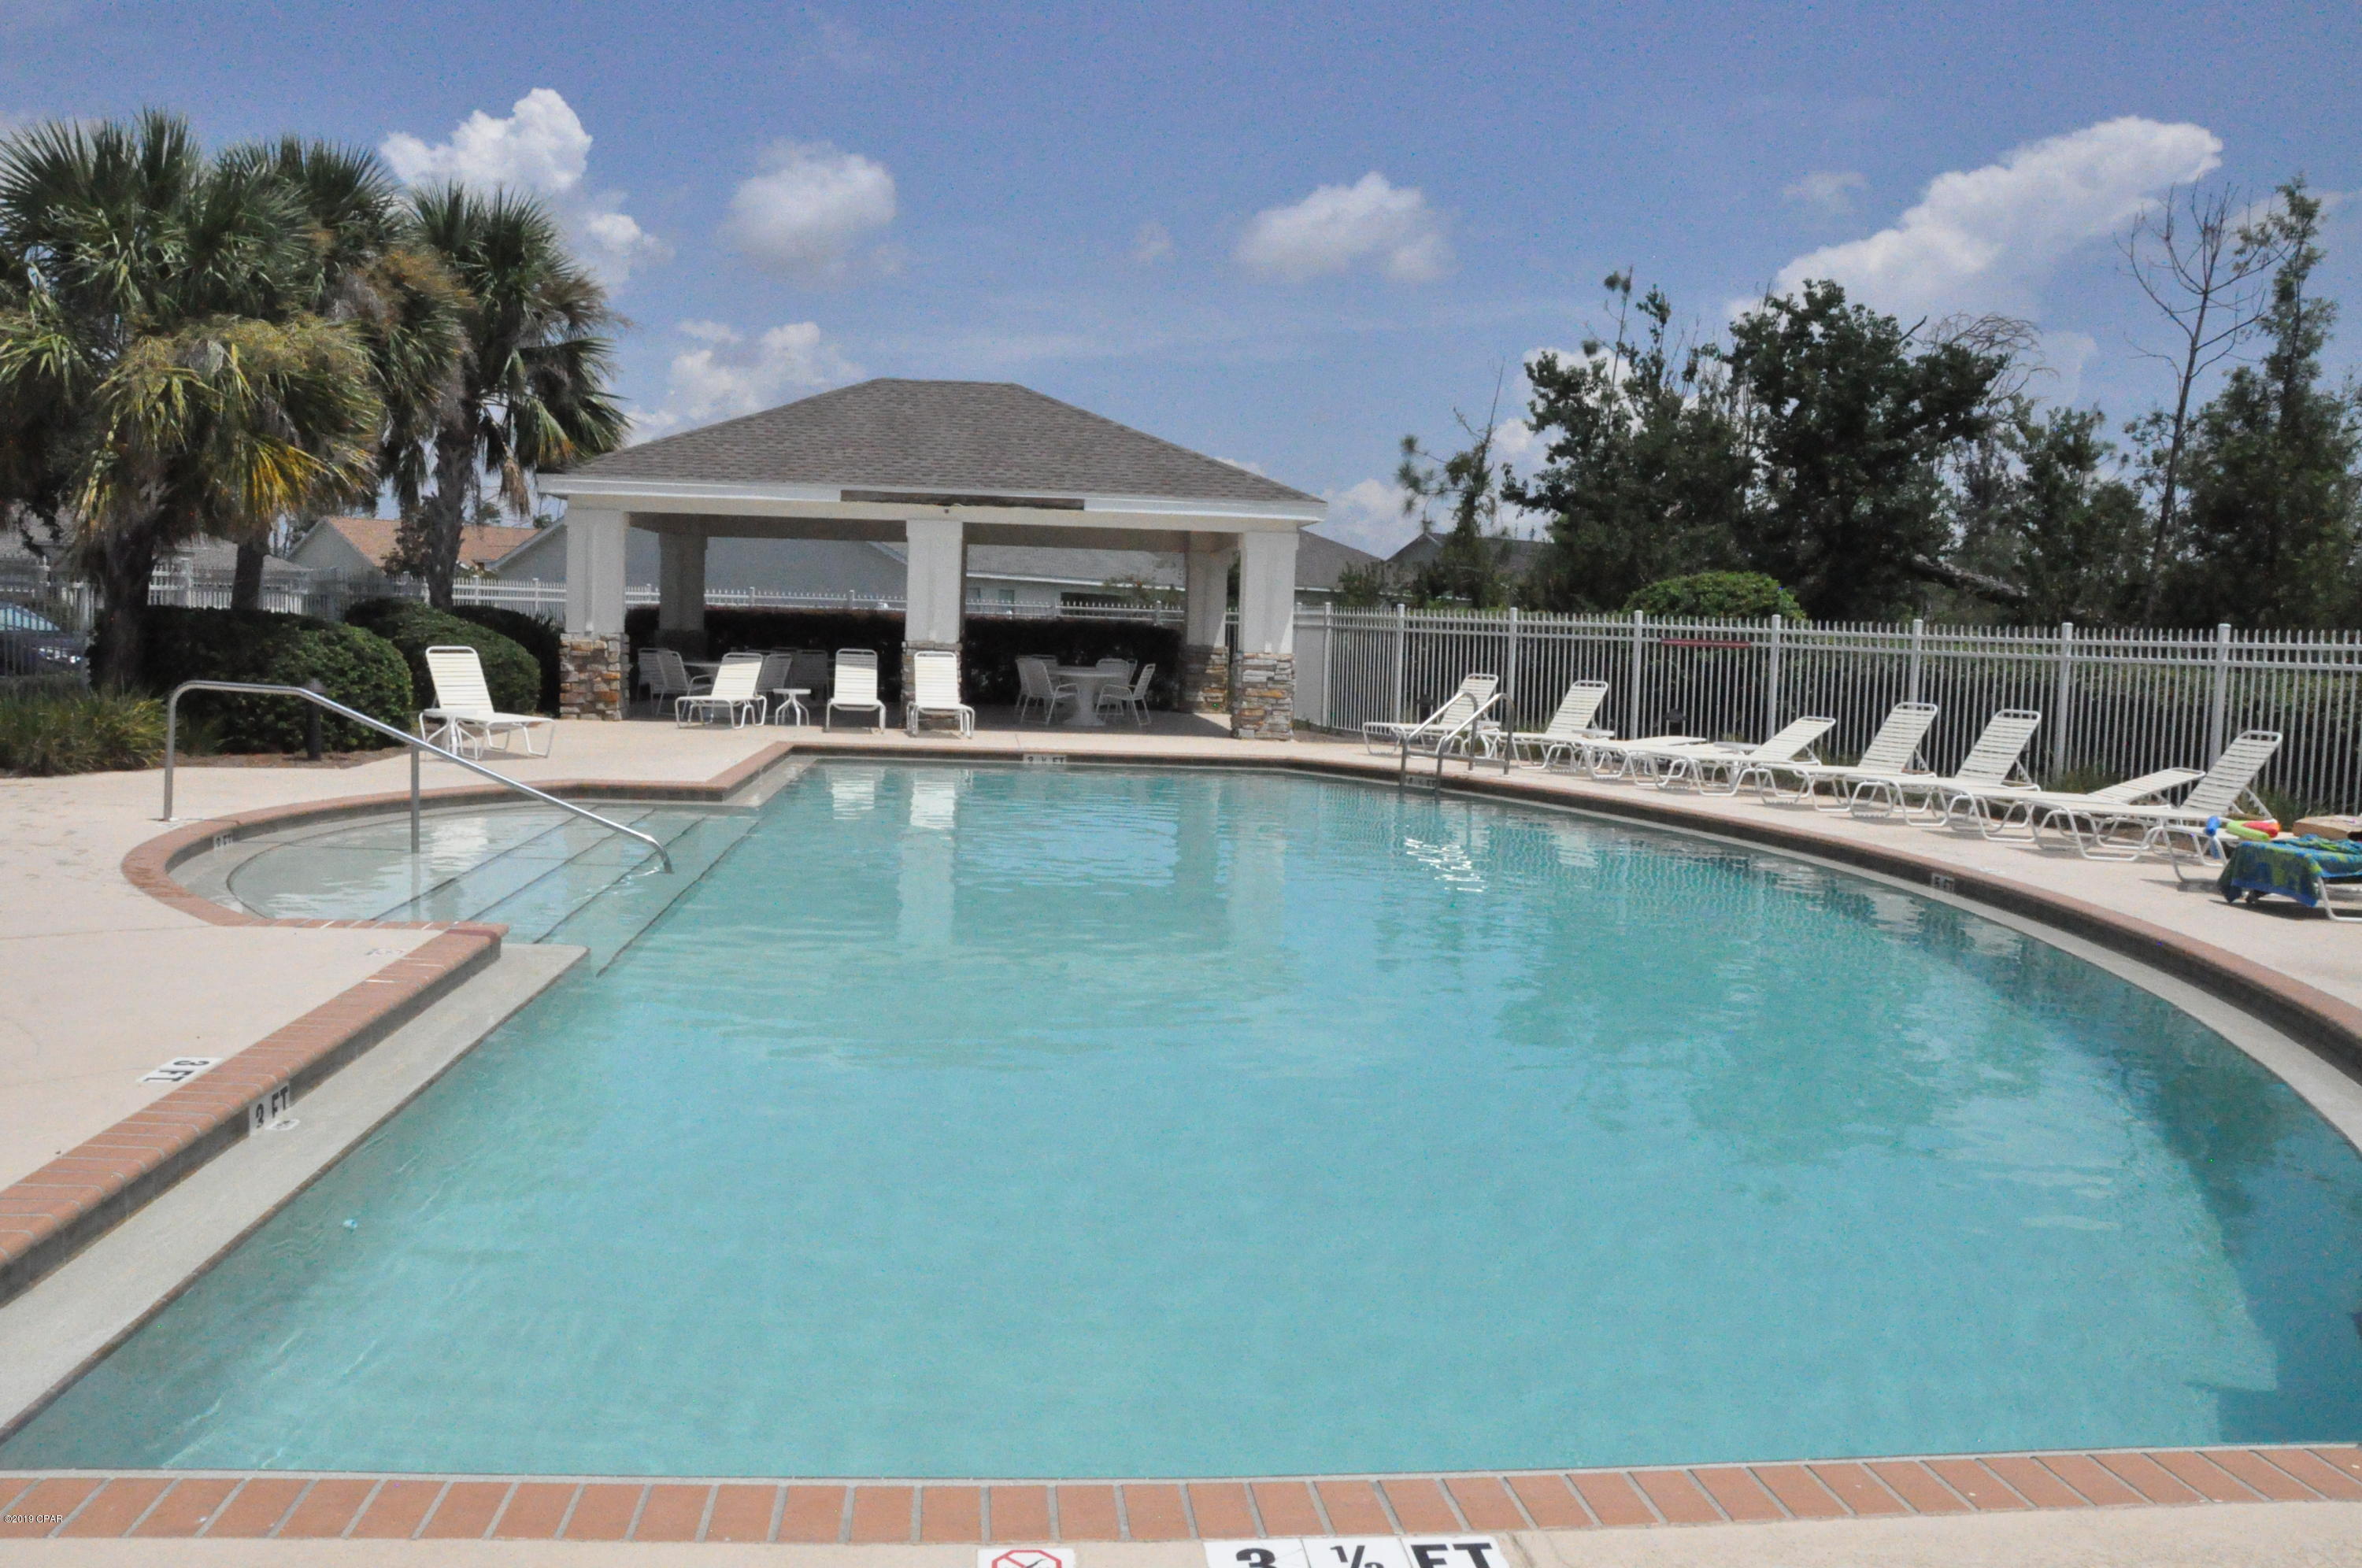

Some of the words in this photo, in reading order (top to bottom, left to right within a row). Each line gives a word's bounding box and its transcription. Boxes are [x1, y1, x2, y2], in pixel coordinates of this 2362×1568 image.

[143, 1070, 195, 1082] FT
[255, 1103, 265, 1129] 3
[272, 1085, 288, 1119] FT
[1235, 1548, 1277, 1568] 3
[1410, 1543, 1493, 1568] FT
